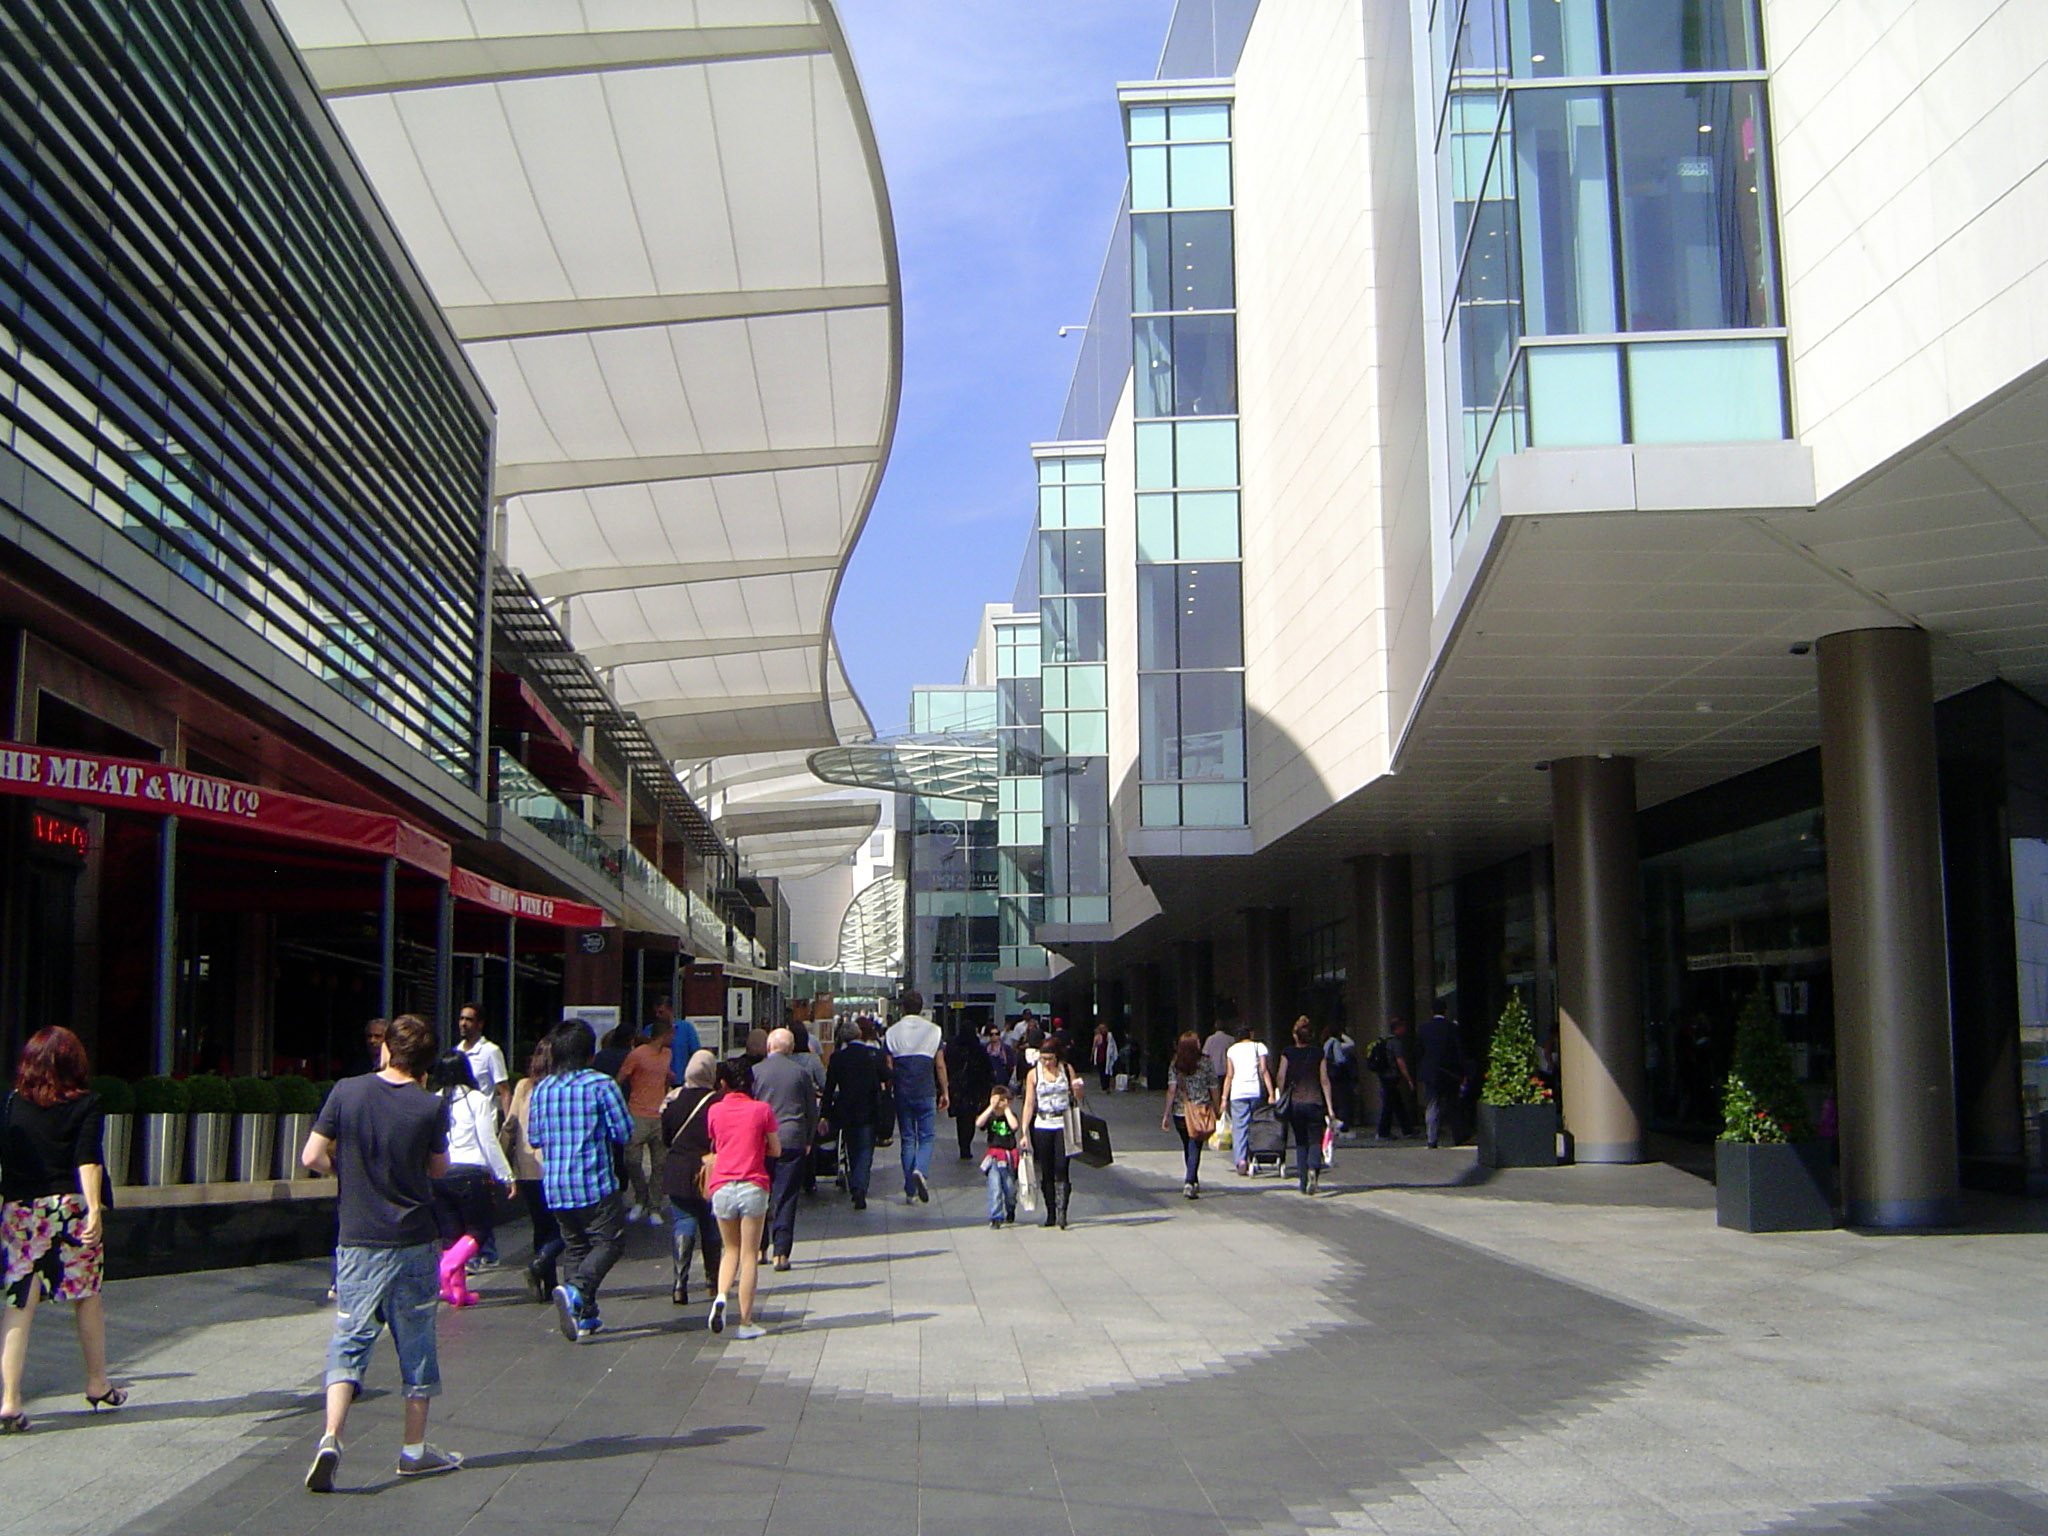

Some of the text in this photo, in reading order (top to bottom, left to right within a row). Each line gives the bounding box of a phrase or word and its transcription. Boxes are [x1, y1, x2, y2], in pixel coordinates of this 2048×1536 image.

[0, 749, 41, 782] HE
[47, 756, 144, 797] MEAT
[146, 776, 167, 800] &
[168, 772, 231, 812] WINE
